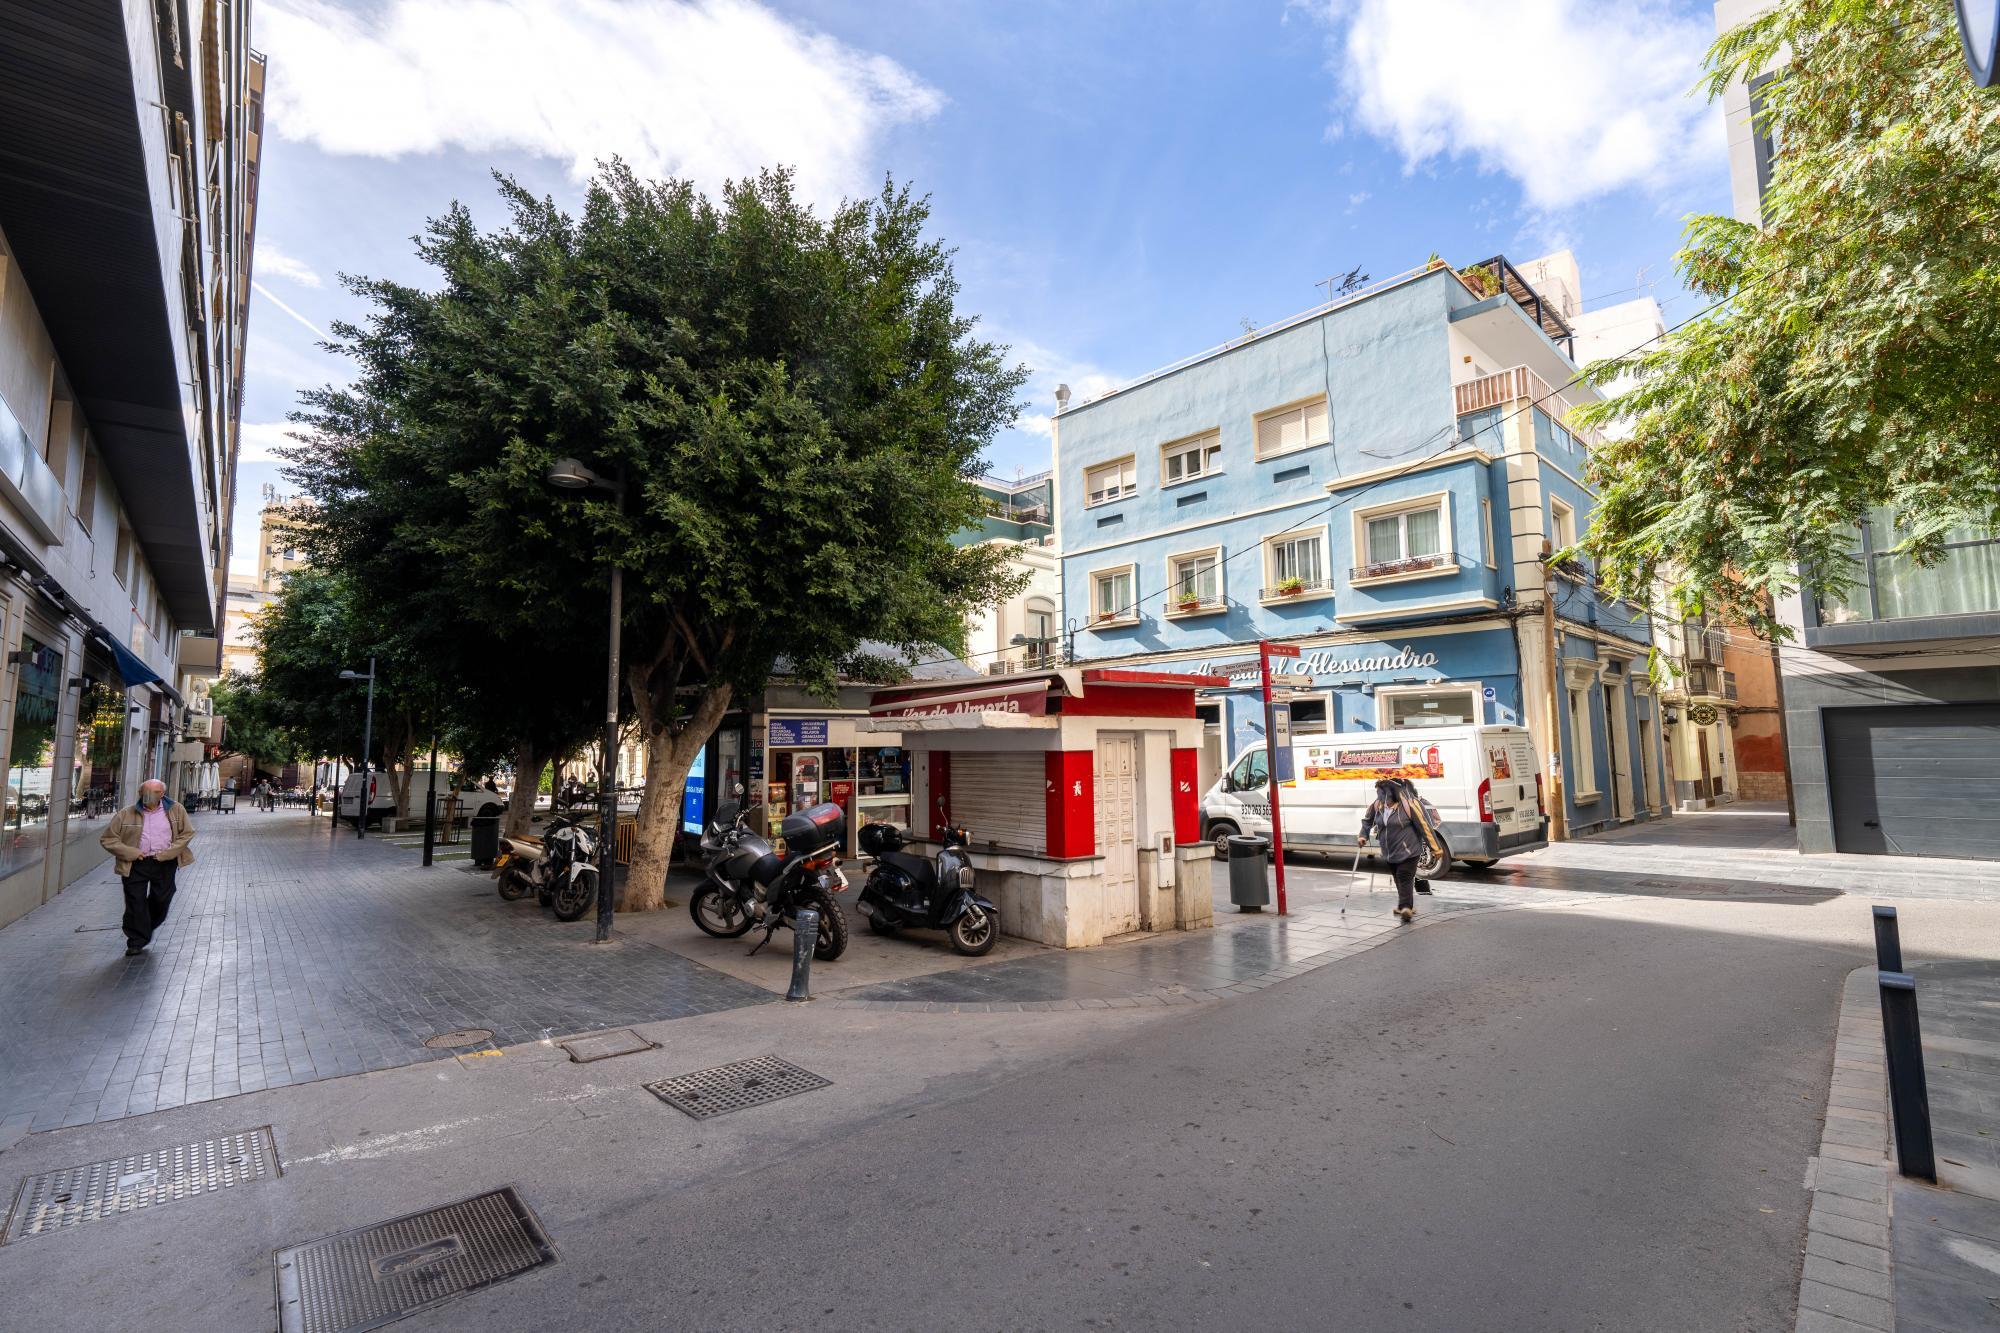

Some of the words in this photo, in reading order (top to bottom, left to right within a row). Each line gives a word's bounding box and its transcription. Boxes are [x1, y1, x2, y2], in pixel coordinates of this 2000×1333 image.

[1293, 645, 1439, 676] Alessandro
[953, 695, 1020, 714] Almería
[1241, 804, 1251, 815] 950
[1252, 804, 1262, 815] 263
